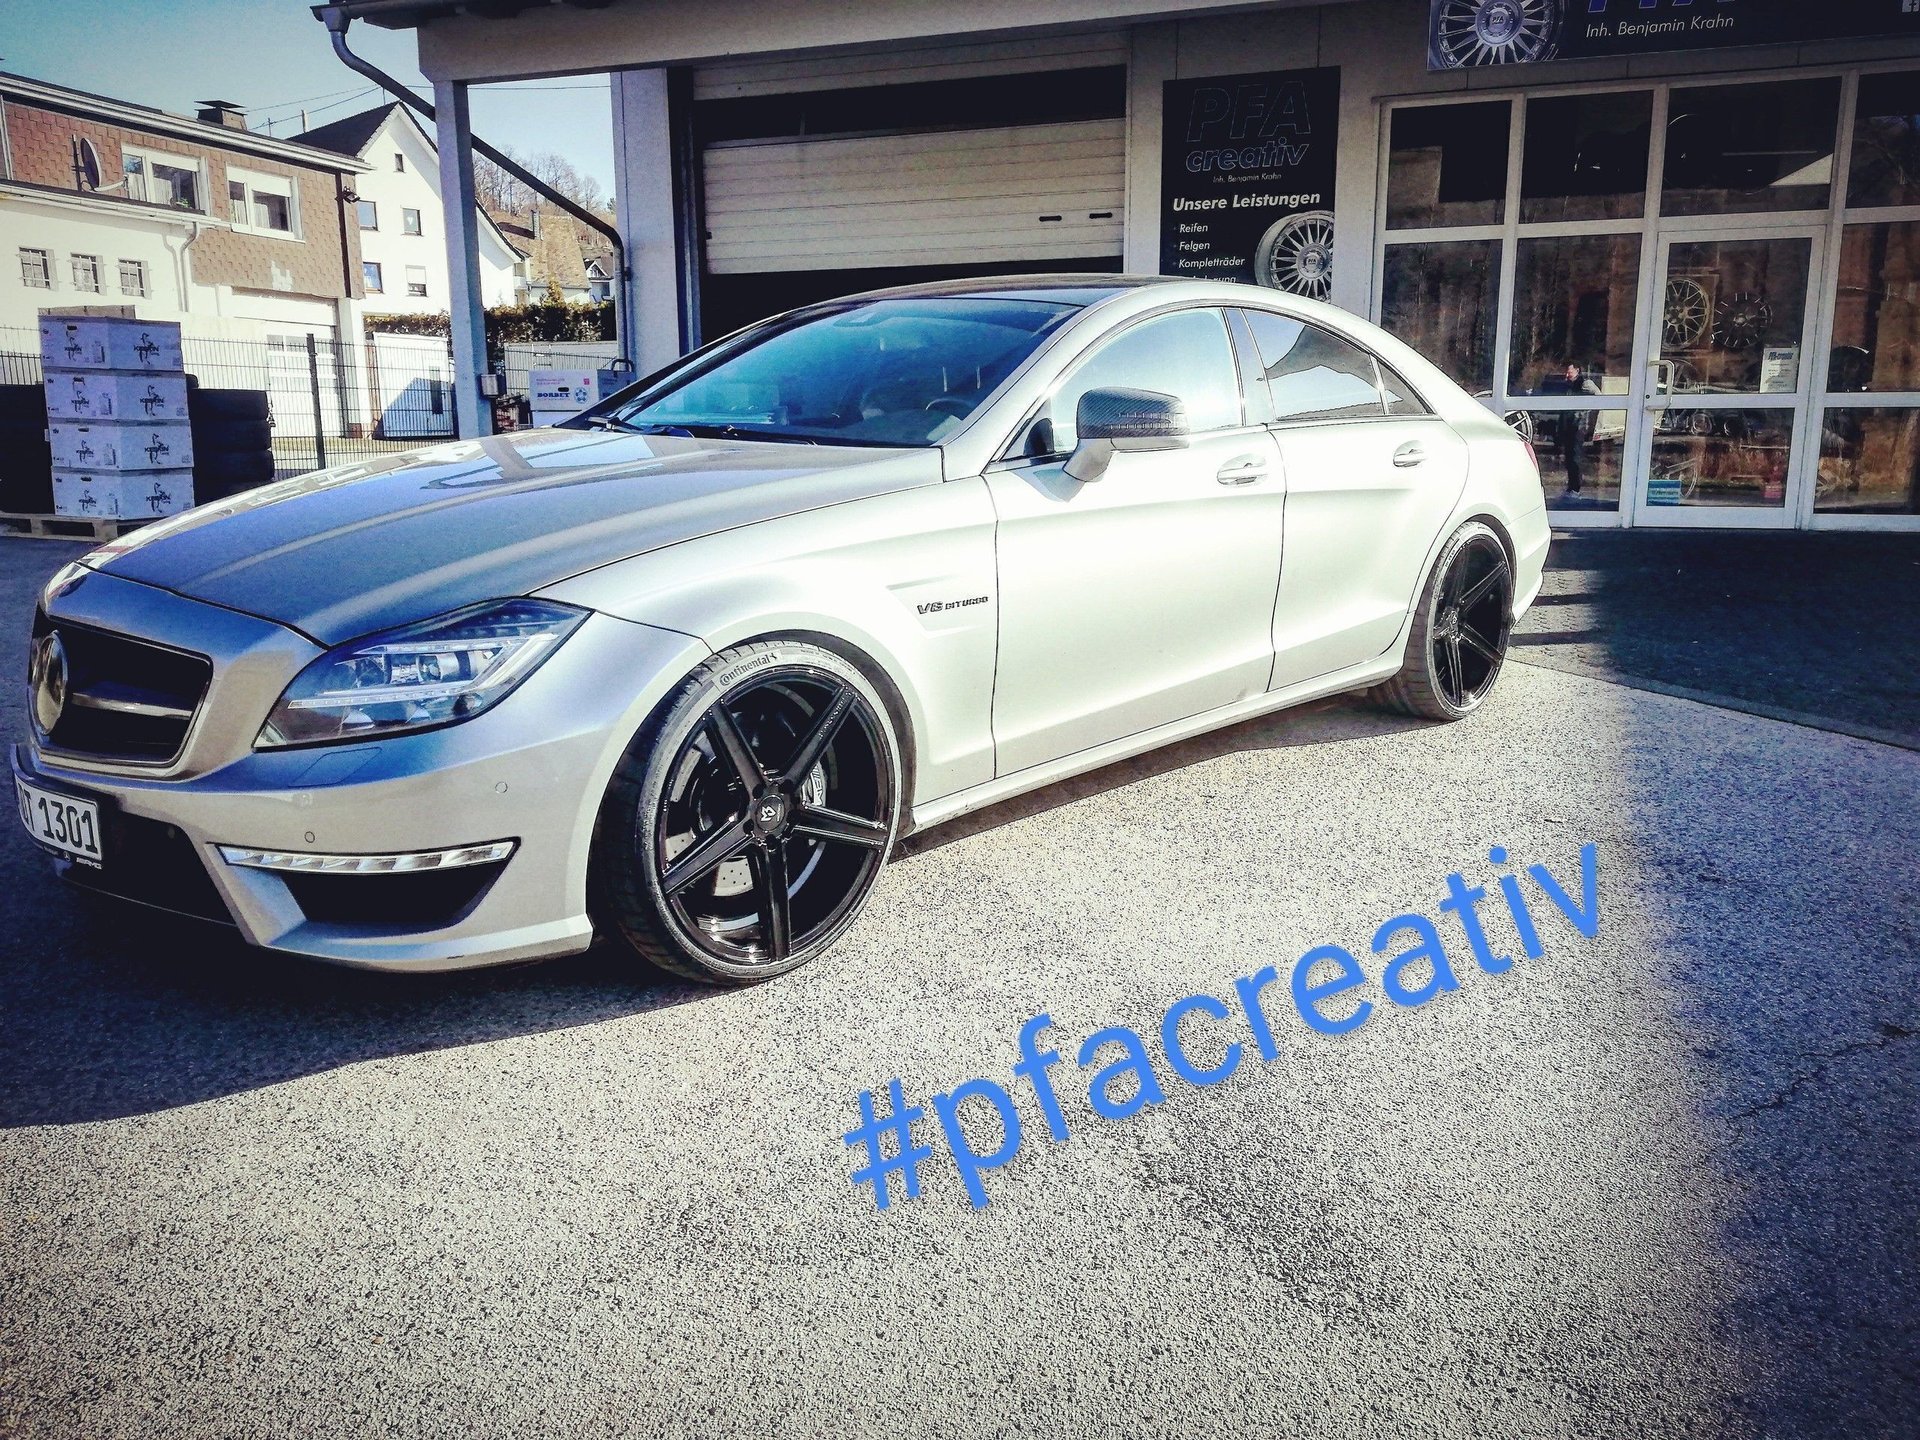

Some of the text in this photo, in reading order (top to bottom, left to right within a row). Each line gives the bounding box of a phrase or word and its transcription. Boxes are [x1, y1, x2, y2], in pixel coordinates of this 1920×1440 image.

[1585, 13, 1734, 38] Inh. Benjamin Krahn
[1187, 80, 1311, 142] PFA
[1186, 137, 1309, 172] creativ
[1212, 172, 1282, 183] Inh. Benjamin Krahn
[1173, 193, 1320, 212] Unsere Leistungen
[1179, 223, 1208, 233] Reifen
[1179, 240, 1211, 252] Felgen
[1178, 256, 1245, 269] Kompletträder
[719, 653, 772, 687] Continental
[38, 797, 98, 854] 1301
